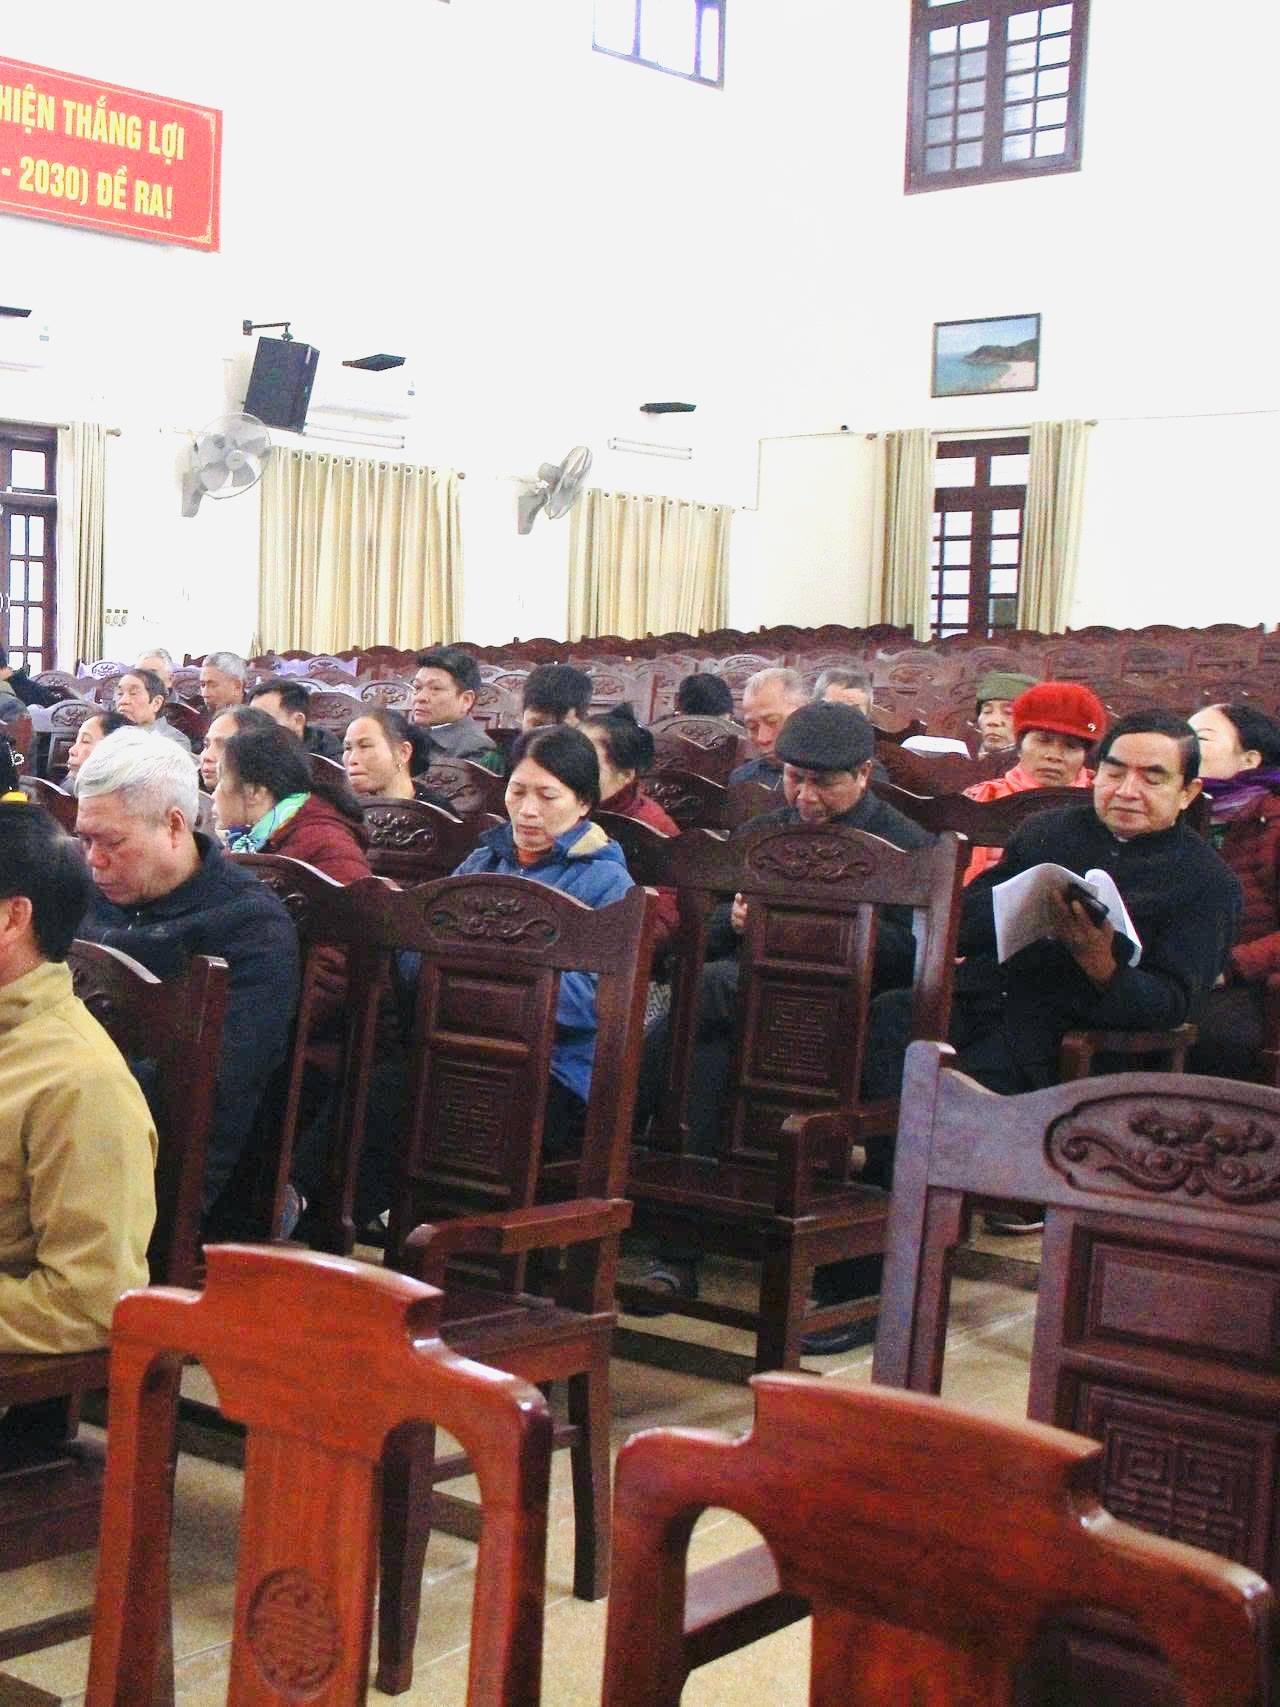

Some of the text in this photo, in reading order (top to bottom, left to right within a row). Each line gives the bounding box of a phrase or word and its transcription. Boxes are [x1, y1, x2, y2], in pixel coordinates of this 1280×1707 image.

[62, 95, 142, 151] THẮNG
[148, 119, 185, 165] LỢI
[18, 155, 89, 206] 2030)
[95, 164, 128, 210] ĐỀ
[133, 179, 174, 220] RA!
